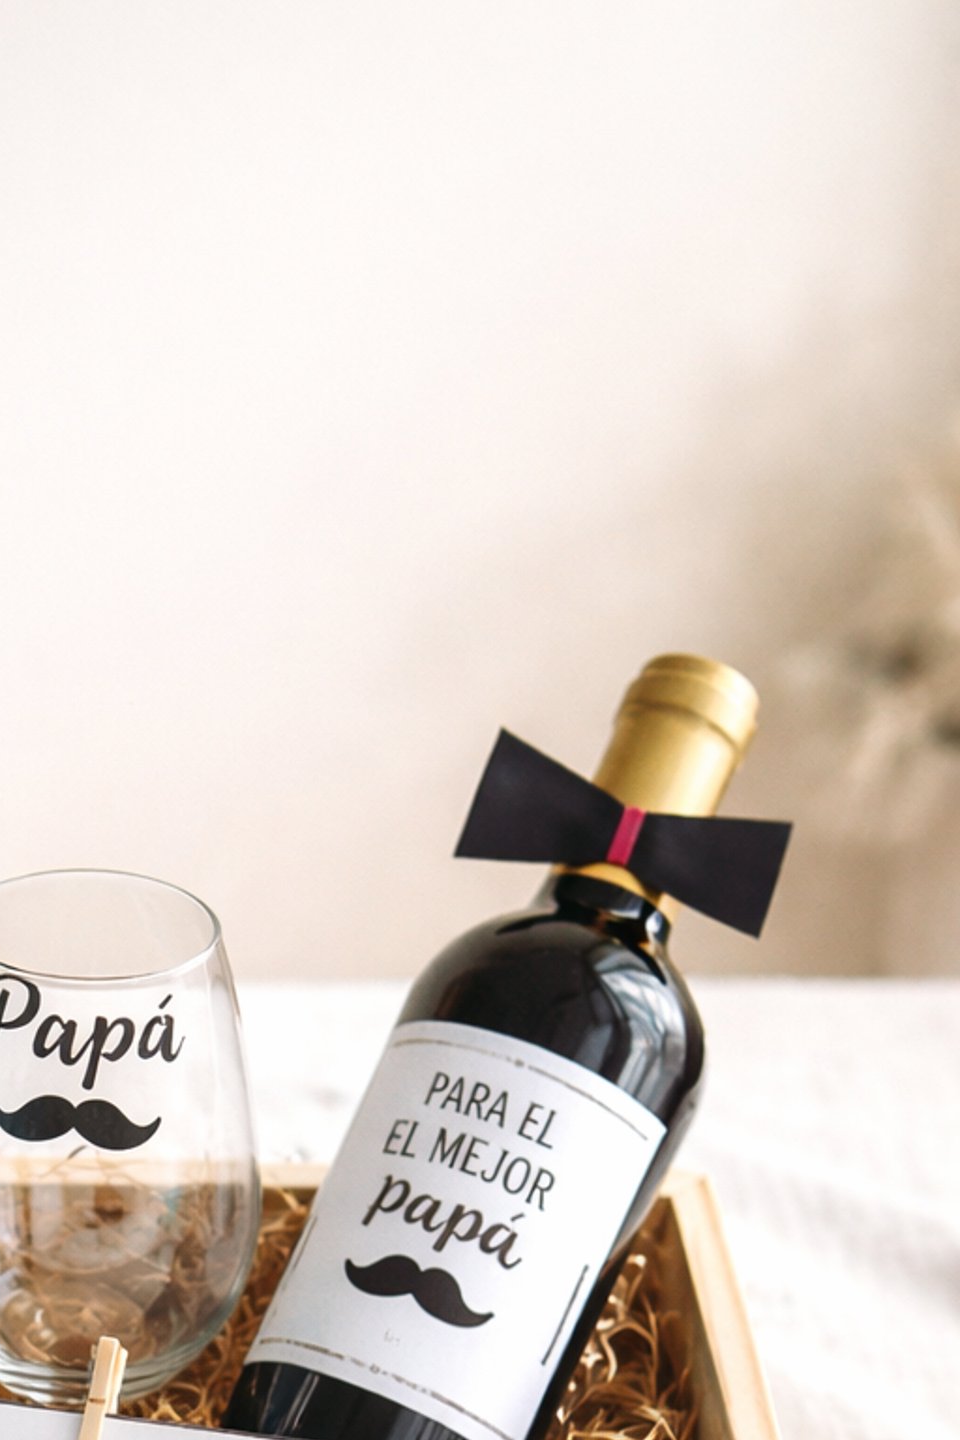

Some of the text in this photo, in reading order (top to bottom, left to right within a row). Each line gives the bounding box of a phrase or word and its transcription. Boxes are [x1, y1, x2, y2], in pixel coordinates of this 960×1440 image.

[423, 1071, 559, 1150] PARA EL
[382, 1118, 557, 1211] EL MEJOR
[361, 1173, 523, 1271] papá
